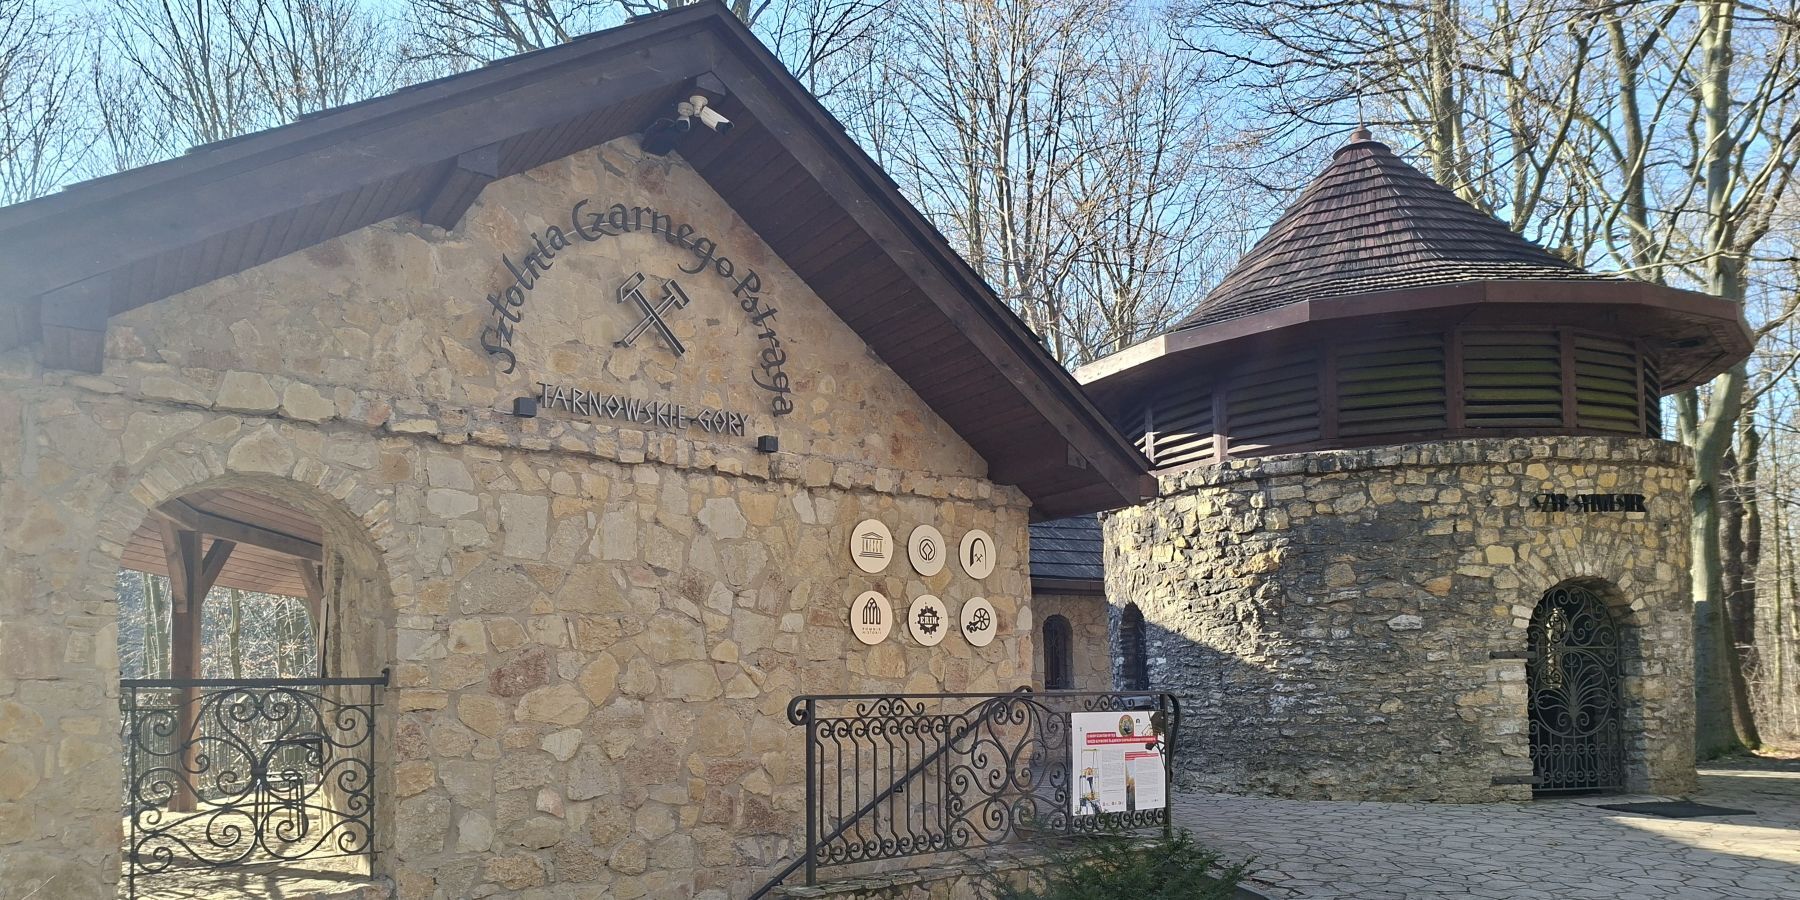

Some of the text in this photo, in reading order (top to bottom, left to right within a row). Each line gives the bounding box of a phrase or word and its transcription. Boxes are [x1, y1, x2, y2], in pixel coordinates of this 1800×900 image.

[480, 232, 572, 375] Sztolnia
[572, 198, 734, 278] Czarnego
[537, 382, 687, 429] TARNOWSKIE
